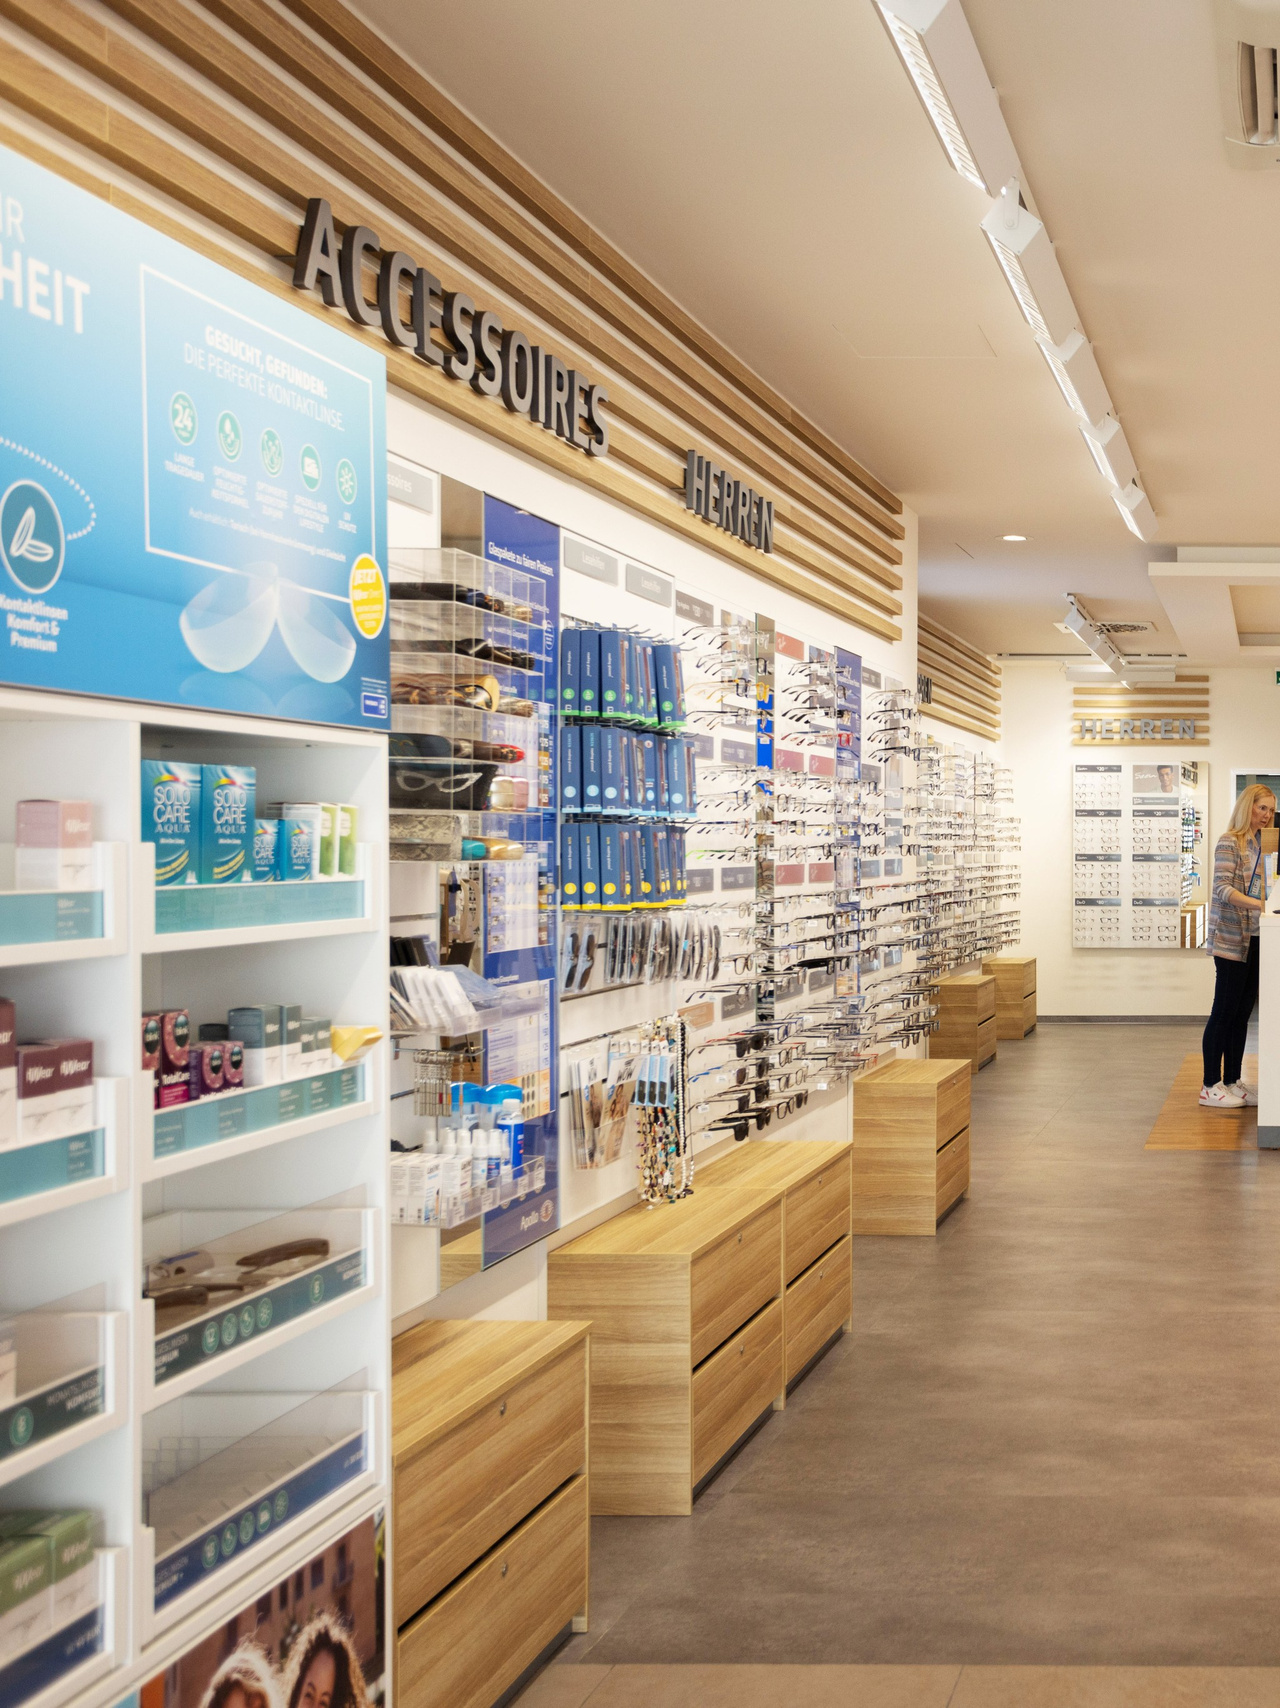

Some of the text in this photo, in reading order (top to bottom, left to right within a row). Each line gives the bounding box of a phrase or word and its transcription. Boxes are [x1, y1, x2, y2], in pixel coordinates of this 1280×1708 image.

[294, 198, 609, 457] ACCESSOIRES
[205, 325, 328, 399] GESUCHT, GEFUNDEN:
[184, 342, 345, 432] DIE PERFEKTE KONTAKTLINSE.
[686, 449, 774, 553] HERREN
[1080, 718, 1195, 740] HERREN
[153, 786, 191, 805] SOLO
[213, 789, 247, 807] SOLO
[153, 805, 191, 823] CARE
[213, 807, 247, 825] CARE
[520, 1210, 539, 1232] Apollo
